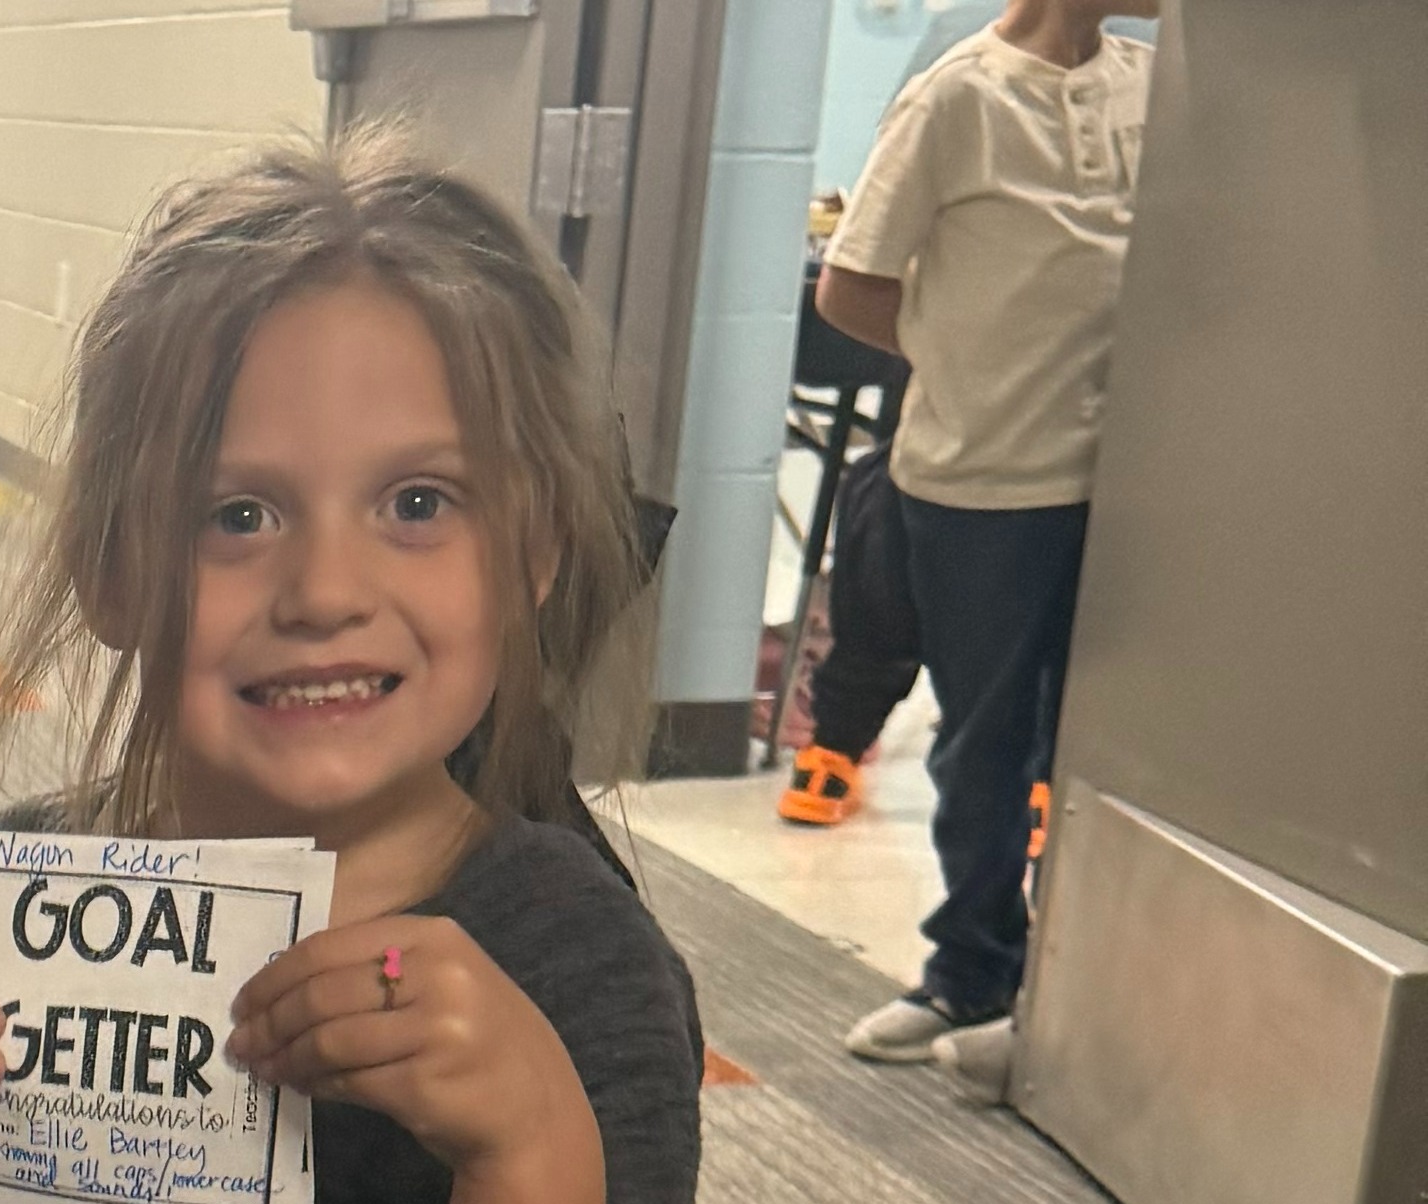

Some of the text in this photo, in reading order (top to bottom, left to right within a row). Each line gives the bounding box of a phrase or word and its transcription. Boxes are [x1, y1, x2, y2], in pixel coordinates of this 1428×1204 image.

[12, 878, 216, 974] GOAL
[29, 1118, 88, 1151] Ellie
[72, 1157, 100, 1179] all
